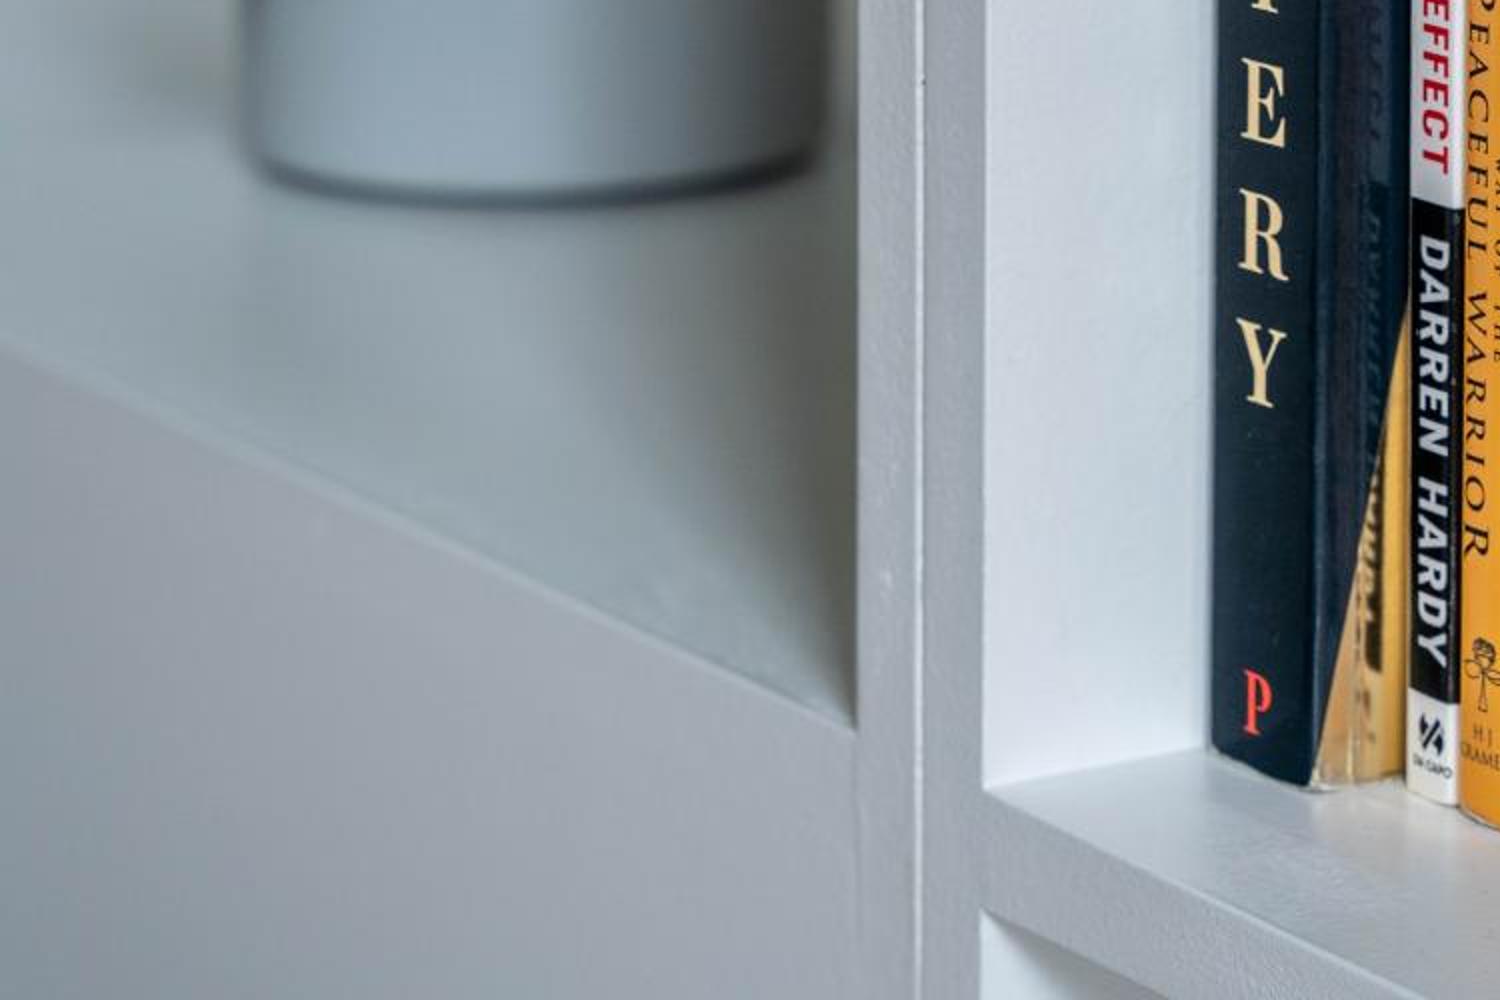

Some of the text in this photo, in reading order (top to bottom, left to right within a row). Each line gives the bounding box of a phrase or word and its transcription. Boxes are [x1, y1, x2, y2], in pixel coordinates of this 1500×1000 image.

[1418, 234, 1450, 669] DARREN HARDY
[1464, 291, 1490, 557] WARRIOR
[1243, 668, 1273, 737] P
